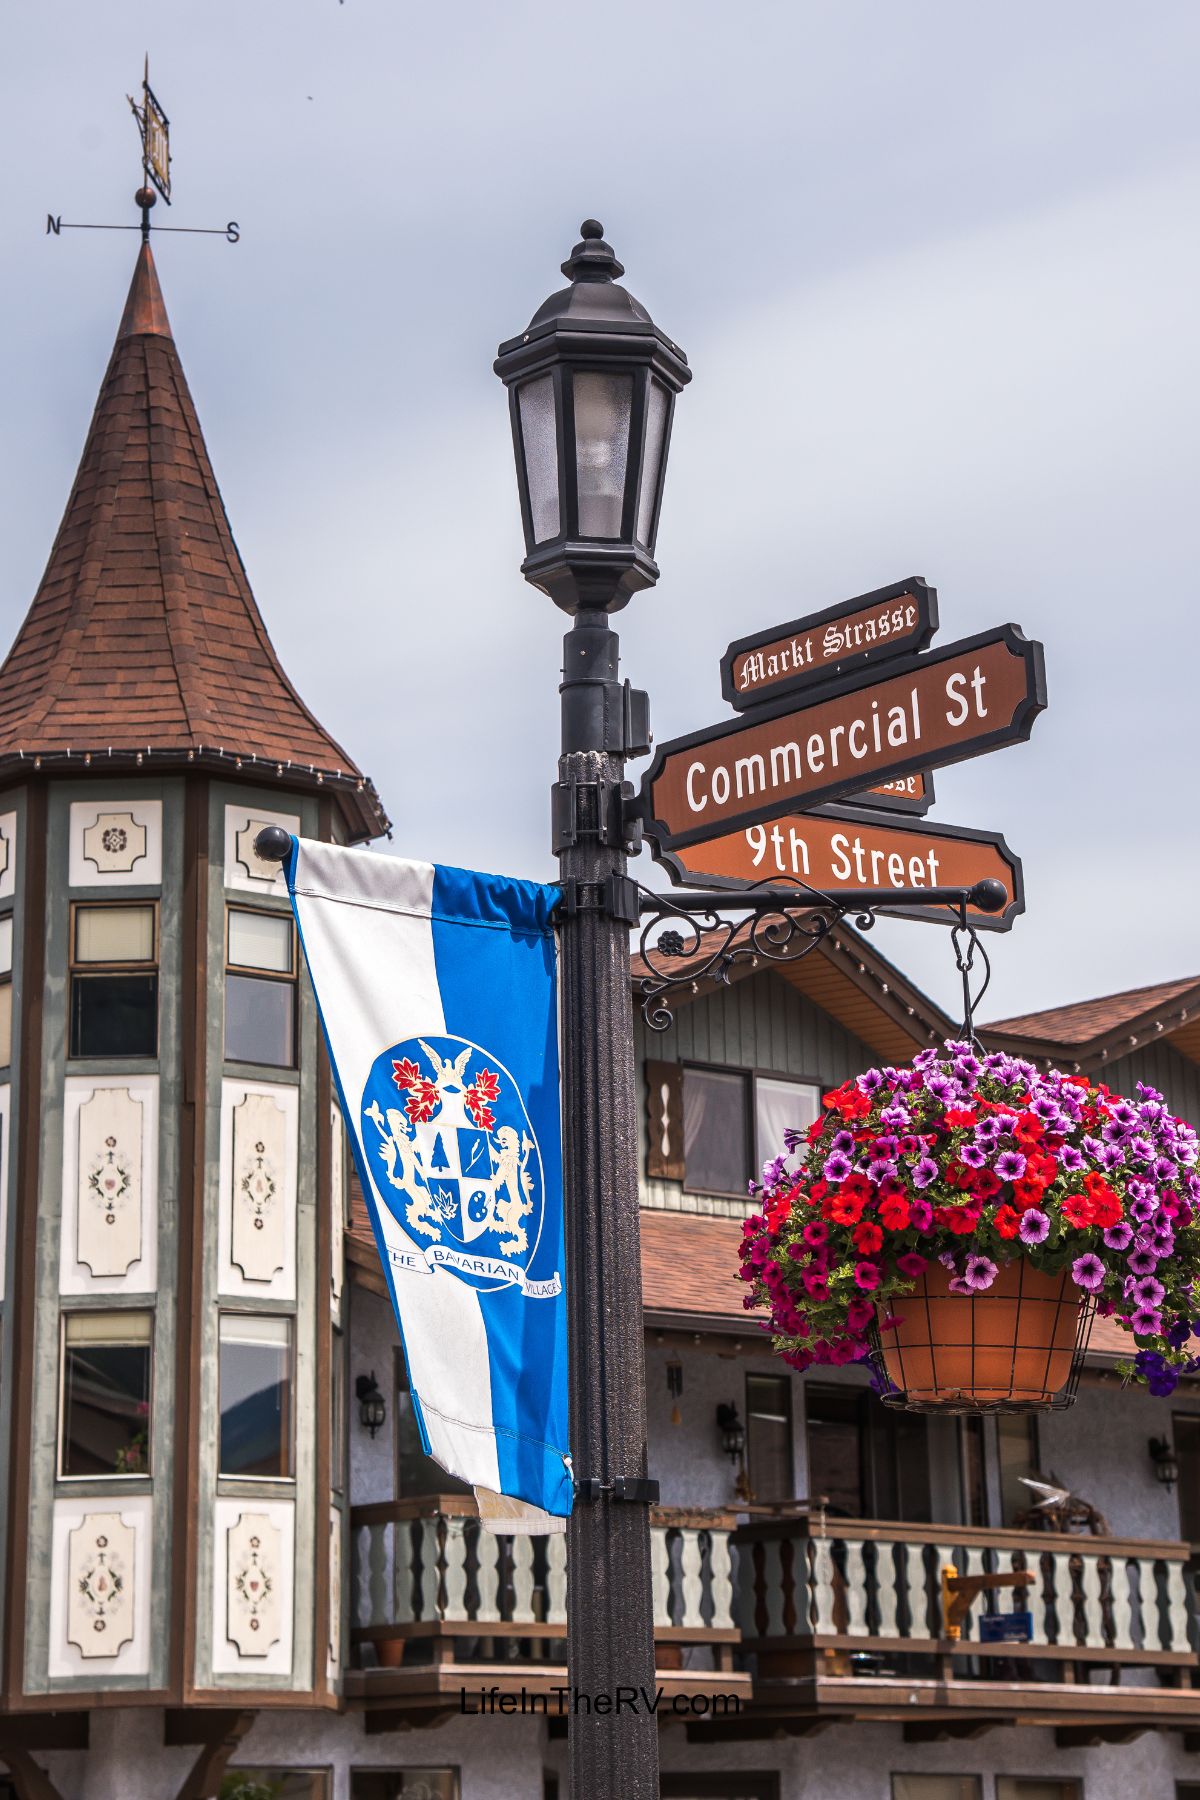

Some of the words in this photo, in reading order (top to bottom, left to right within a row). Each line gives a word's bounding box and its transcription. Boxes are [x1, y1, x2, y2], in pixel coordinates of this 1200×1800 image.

[46, 214, 61, 235] N
[226, 221, 240, 243] S
[740, 639, 814, 689] Markt
[823, 604, 916, 657] Strasse
[686, 688, 921, 812] Commercial
[946, 666, 988, 727] St
[745, 824, 810, 875] 9th
[831, 833, 940, 888] Street
